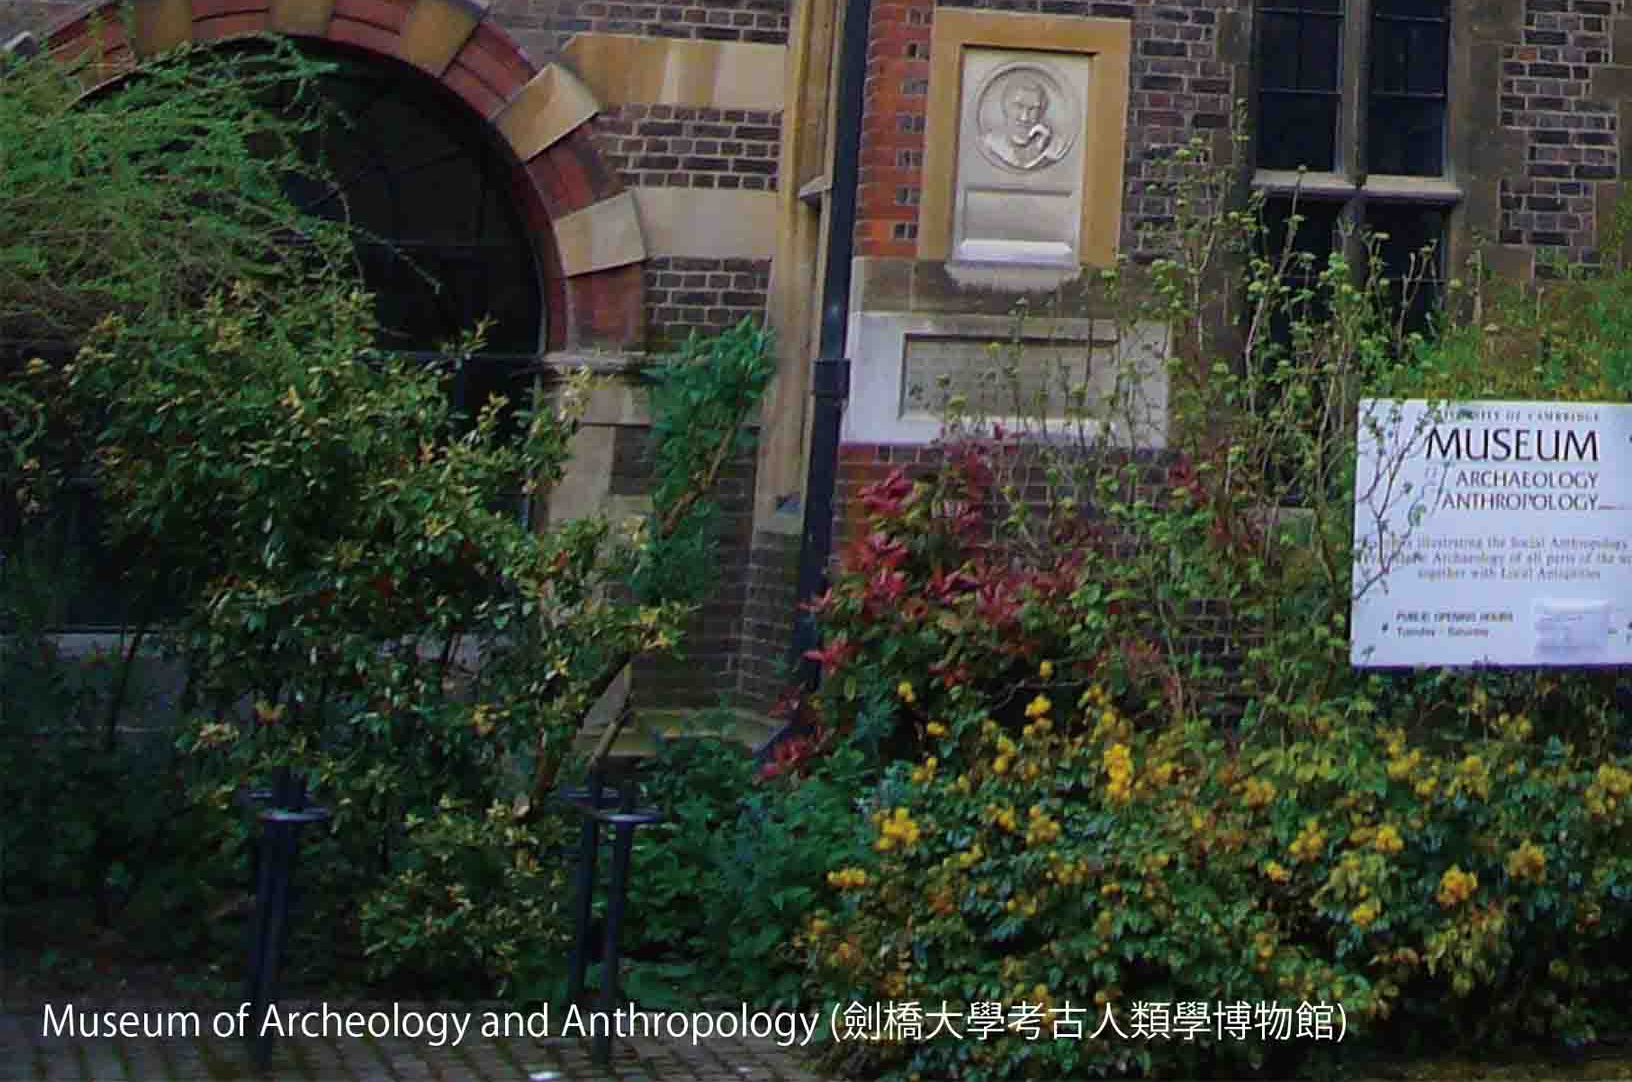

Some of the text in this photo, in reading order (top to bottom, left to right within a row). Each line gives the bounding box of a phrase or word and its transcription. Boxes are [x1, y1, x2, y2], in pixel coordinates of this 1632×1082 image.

[1426, 427, 1599, 462] MUSEUM
[1456, 470, 1599, 489] ARCHAEOLOGY
[1442, 493, 1599, 510] ANTHROPOLOGY
